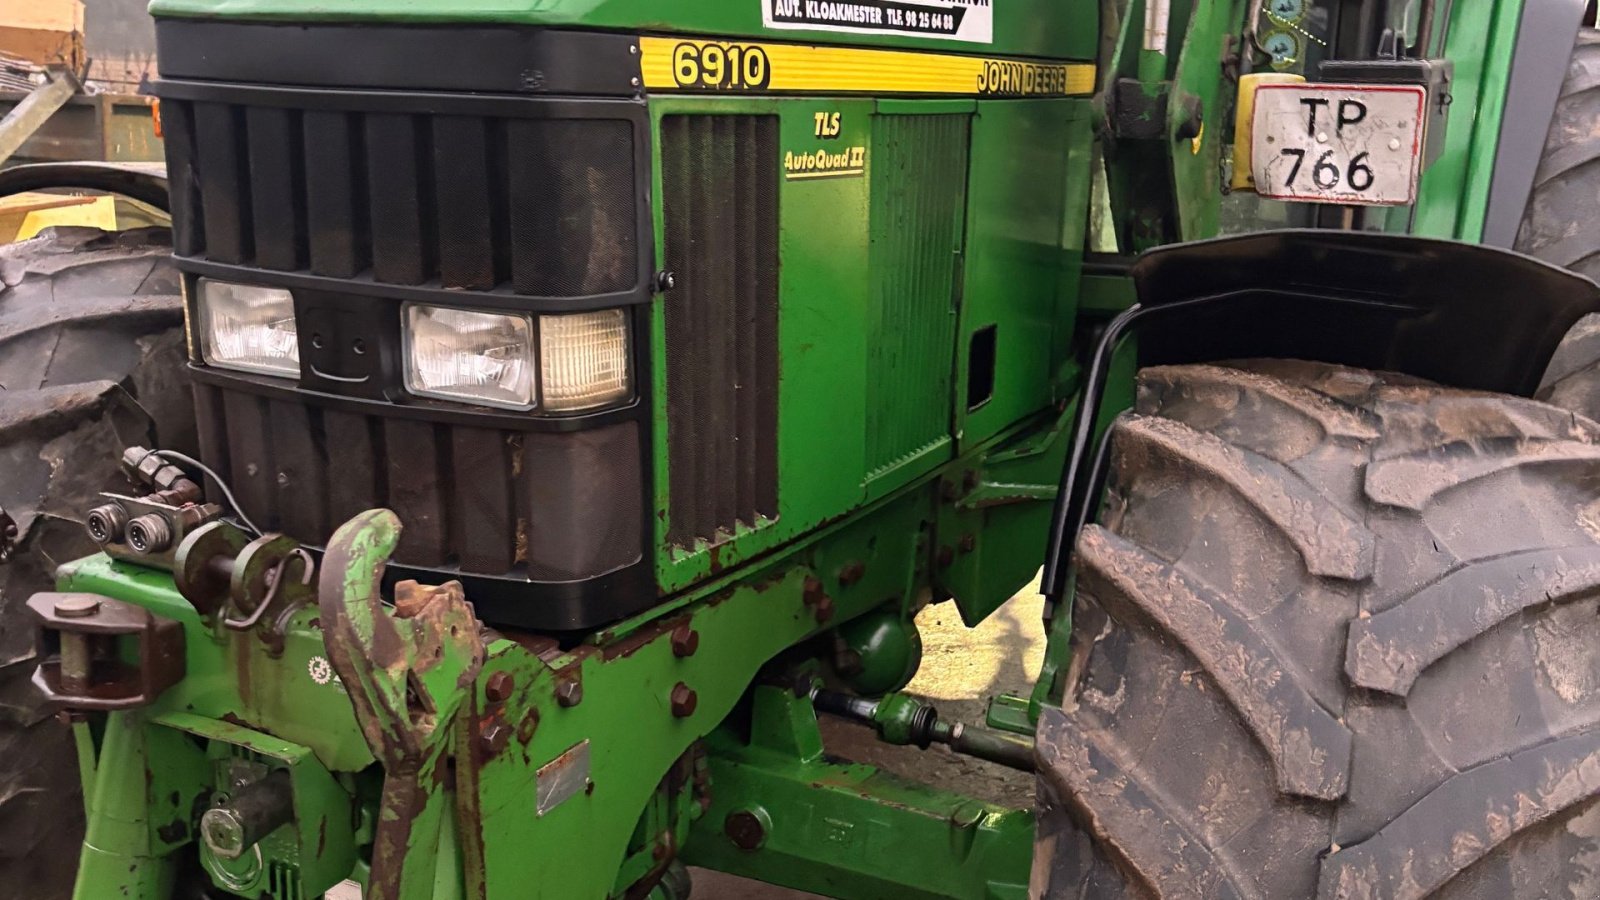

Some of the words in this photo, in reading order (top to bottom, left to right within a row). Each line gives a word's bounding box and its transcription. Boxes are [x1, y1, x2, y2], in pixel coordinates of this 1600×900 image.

[775, 0, 803, 18] AUT.
[805, 0, 883, 24] KLOAKMESTER
[905, 10, 917, 28] 98
[919, 12, 930, 29] 25
[931, 13, 942, 29] 64
[673, 43, 769, 87] 6910
[977, 61, 1023, 93] JOHN
[1024, 64, 1067, 94] DEERE
[814, 112, 841, 138] TLS
[1300, 98, 1367, 138] TP
[784, 147, 850, 170] AutoQuad
[850, 147, 865, 167] II
[1281, 148, 1374, 192] 766
